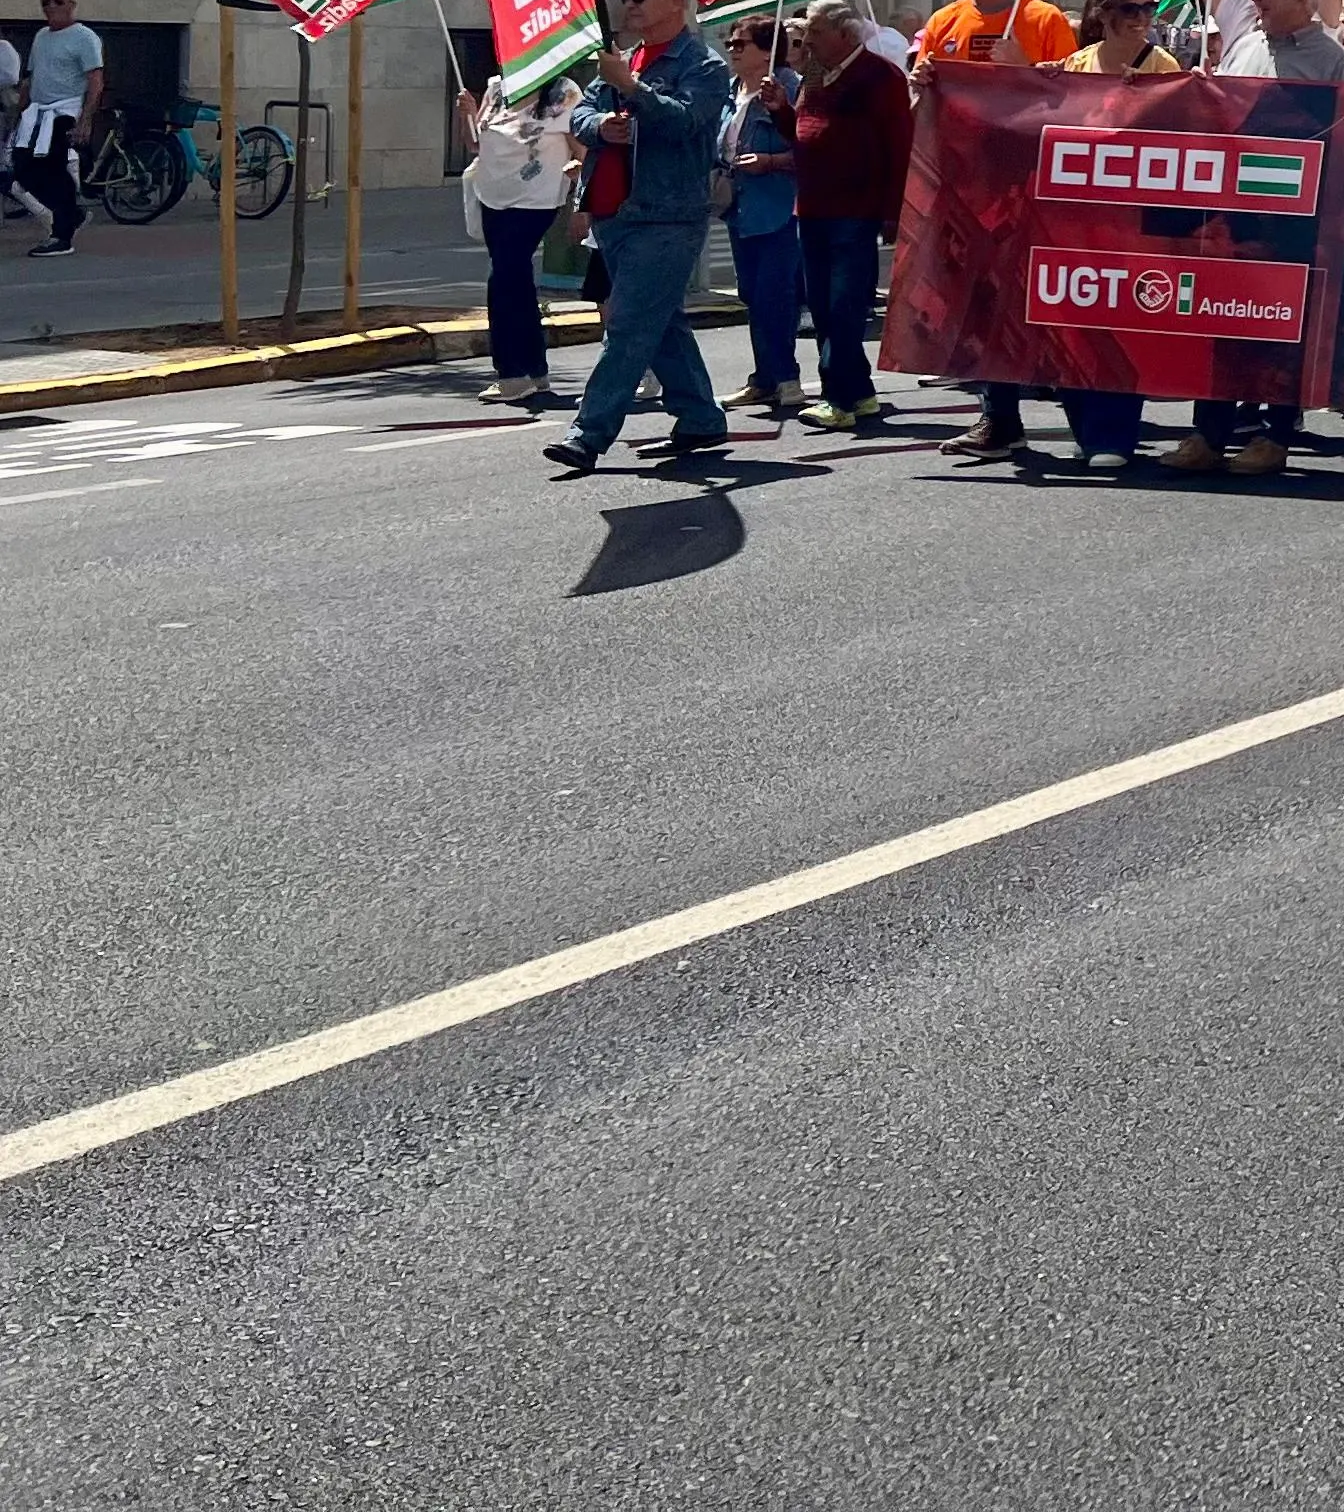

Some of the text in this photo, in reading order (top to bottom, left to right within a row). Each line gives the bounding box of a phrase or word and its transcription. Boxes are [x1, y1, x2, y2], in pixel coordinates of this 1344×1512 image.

[1050, 141, 1226, 194] CCOO
[1037, 263, 1293, 322] UGT Andalucía
